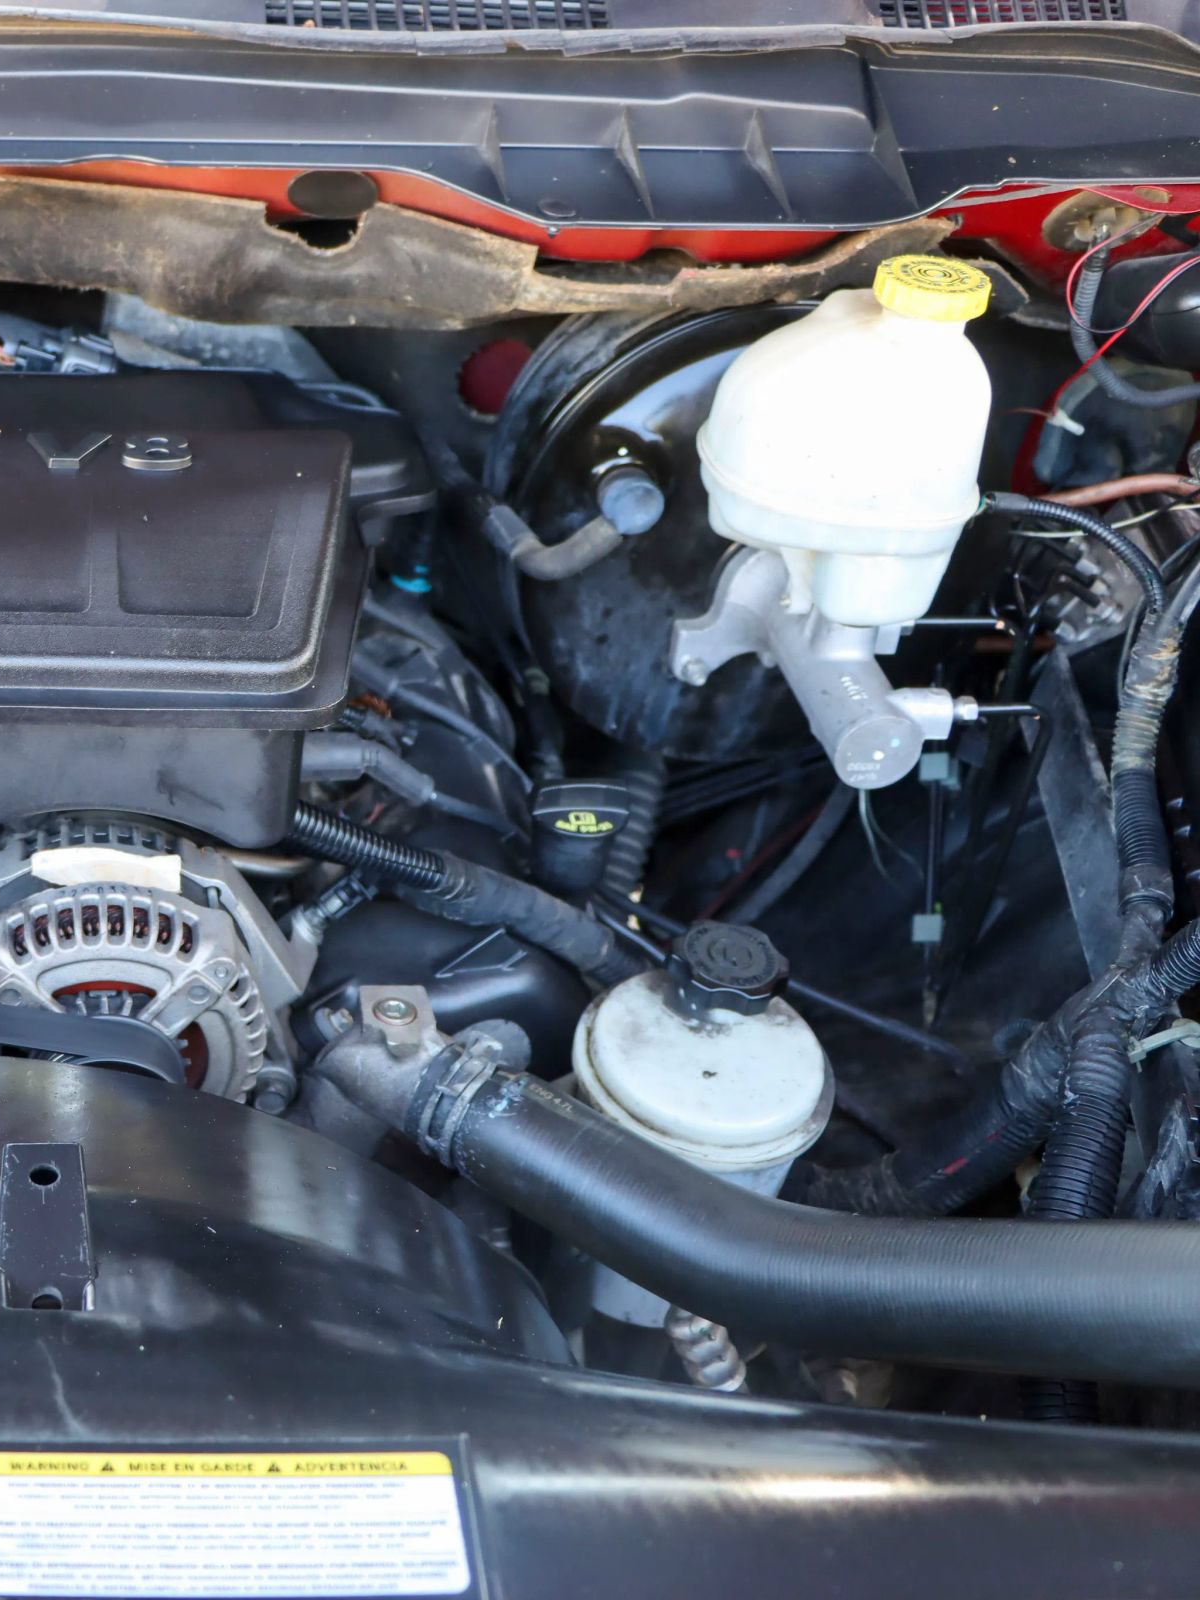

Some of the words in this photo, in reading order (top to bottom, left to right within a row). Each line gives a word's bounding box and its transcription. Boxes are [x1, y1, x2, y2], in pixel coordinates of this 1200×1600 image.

[26, 432, 193, 471] V8
[10, 1461, 90, 1472] WARNING
[129, 1461, 167, 1472] MISE
[174, 1461, 195, 1472] EN
[201, 1462, 254, 1472] GARDE
[294, 1461, 408, 1472] ADVERTENCIA
